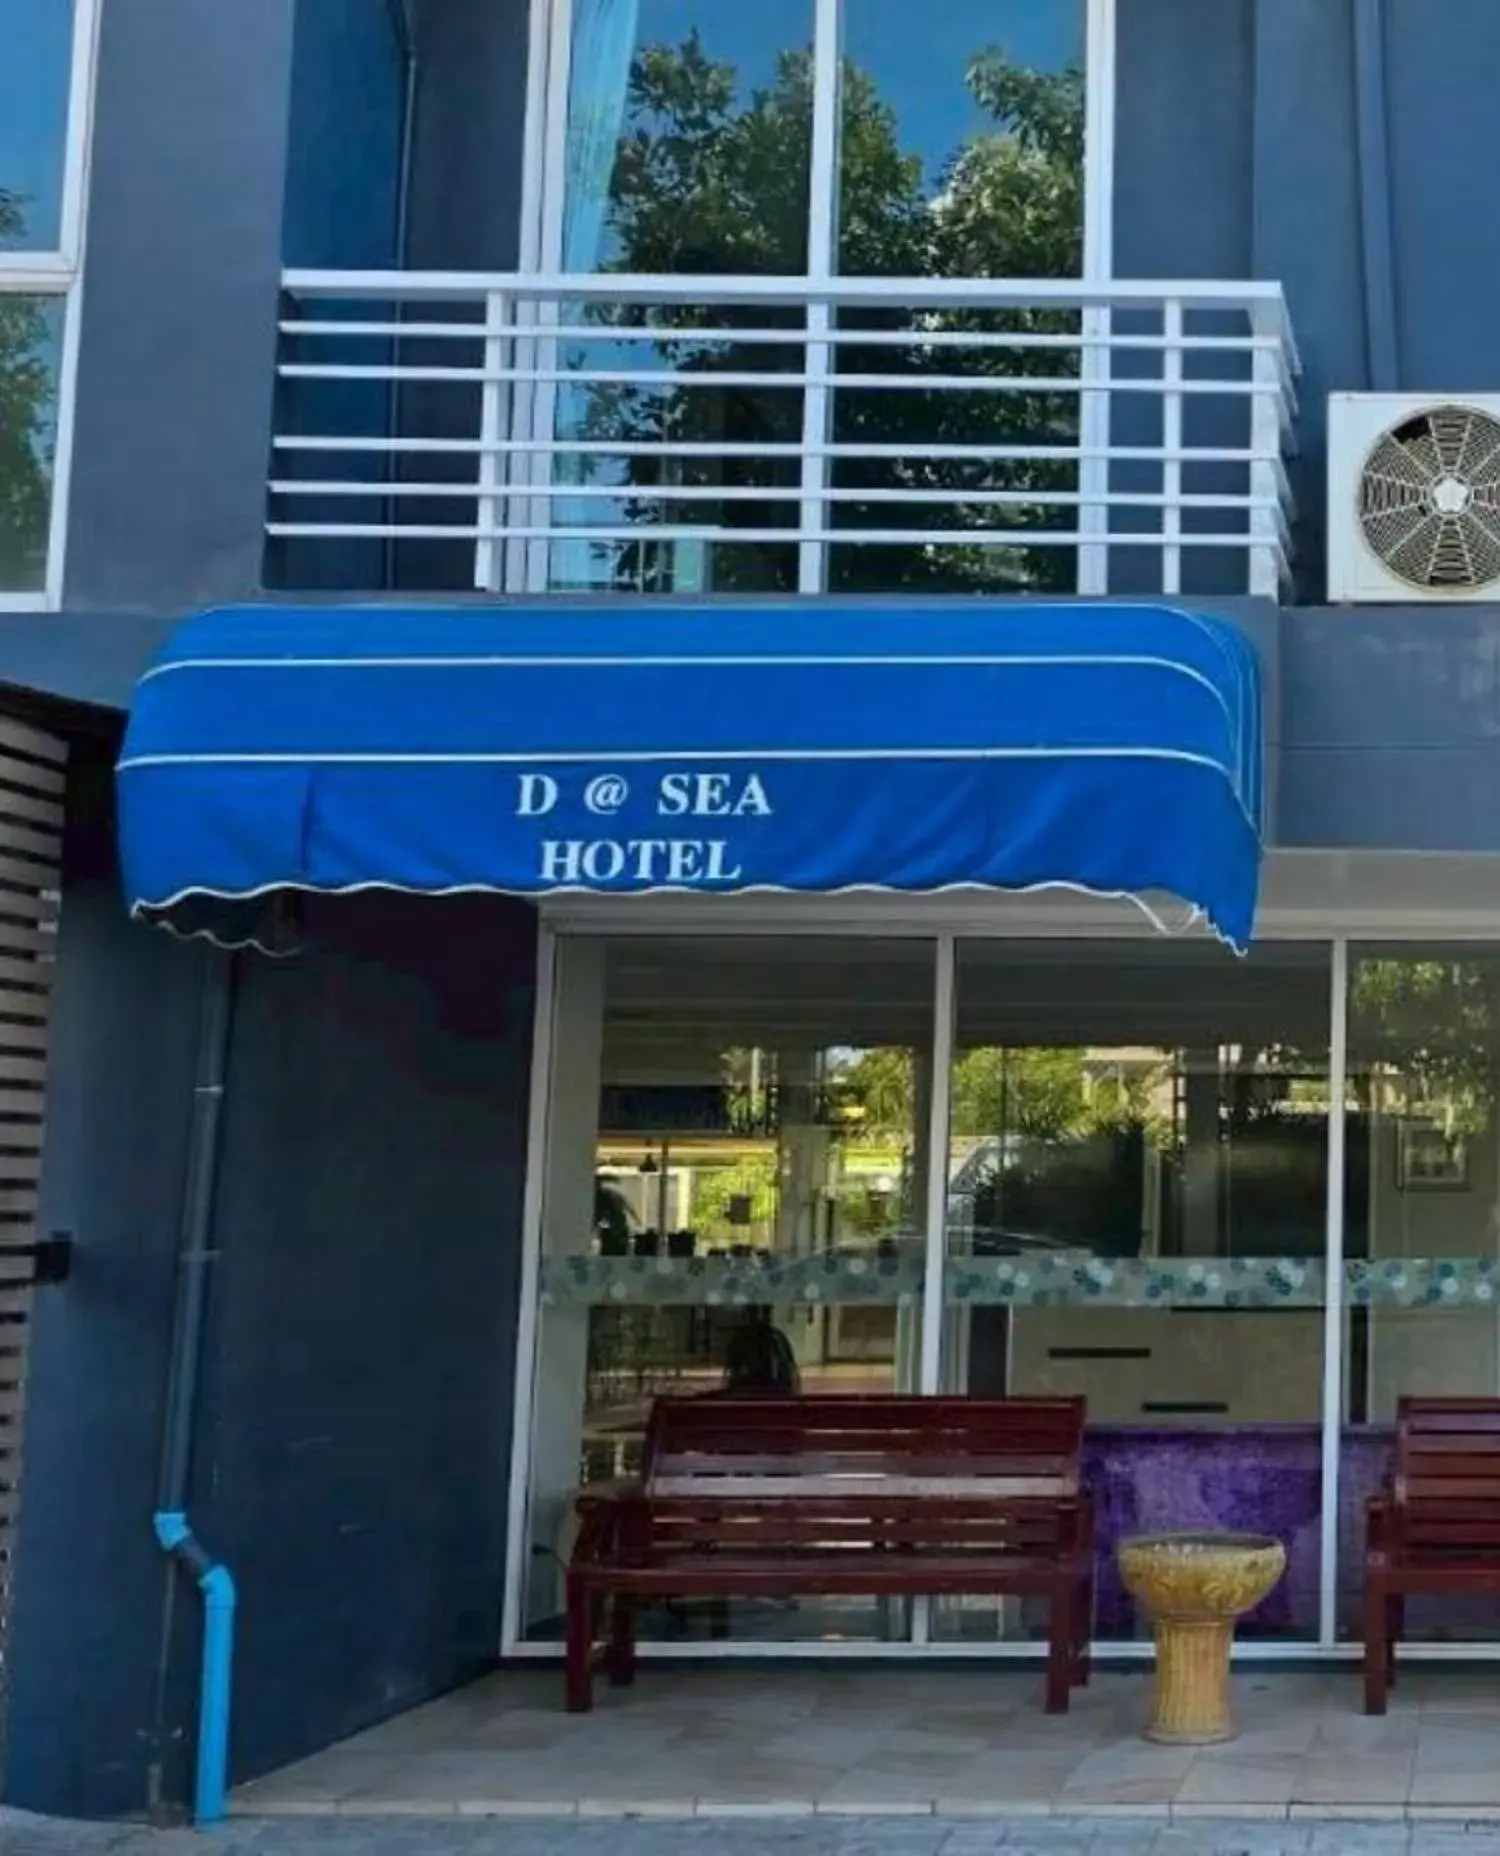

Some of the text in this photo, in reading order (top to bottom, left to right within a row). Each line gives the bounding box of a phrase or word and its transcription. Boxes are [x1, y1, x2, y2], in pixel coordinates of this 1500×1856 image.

[516, 772, 772, 816] D @ SEA
[539, 840, 742, 881] HOTEL
